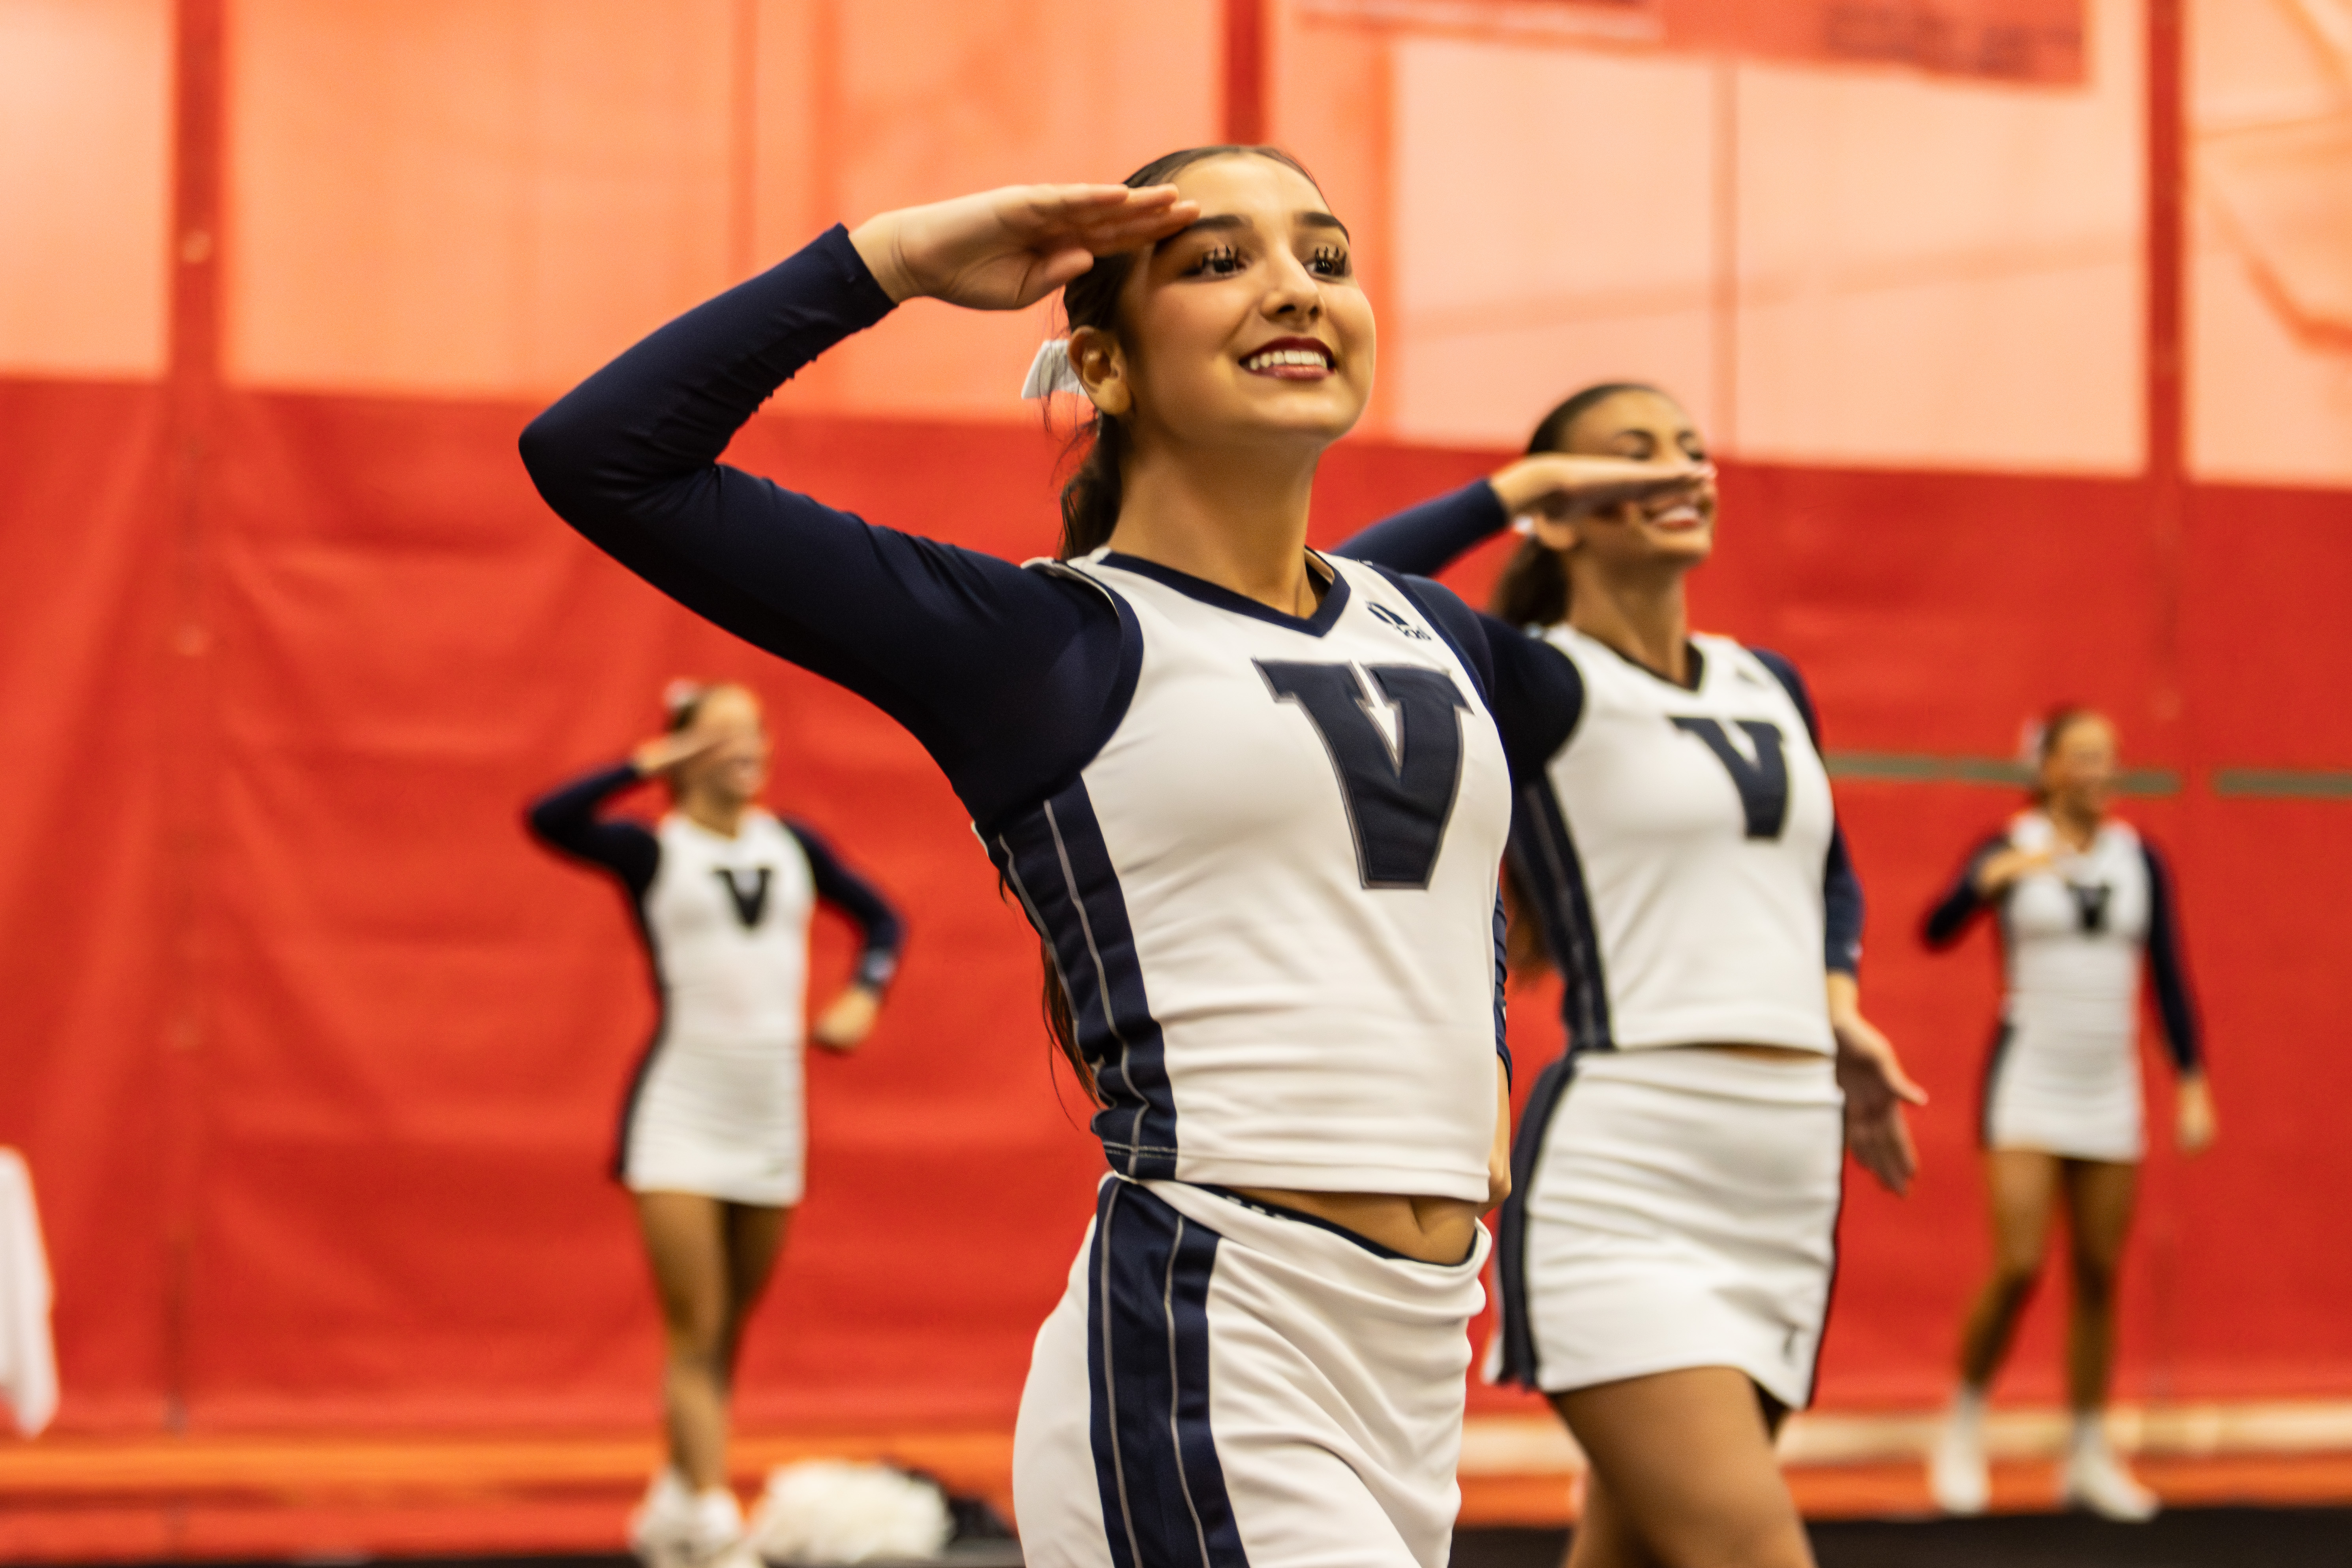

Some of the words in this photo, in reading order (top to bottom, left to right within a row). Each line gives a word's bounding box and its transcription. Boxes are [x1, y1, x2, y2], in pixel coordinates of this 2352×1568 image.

[1251, 657, 1475, 891] V
[1667, 715, 1789, 840] V
[710, 864, 775, 931] V
